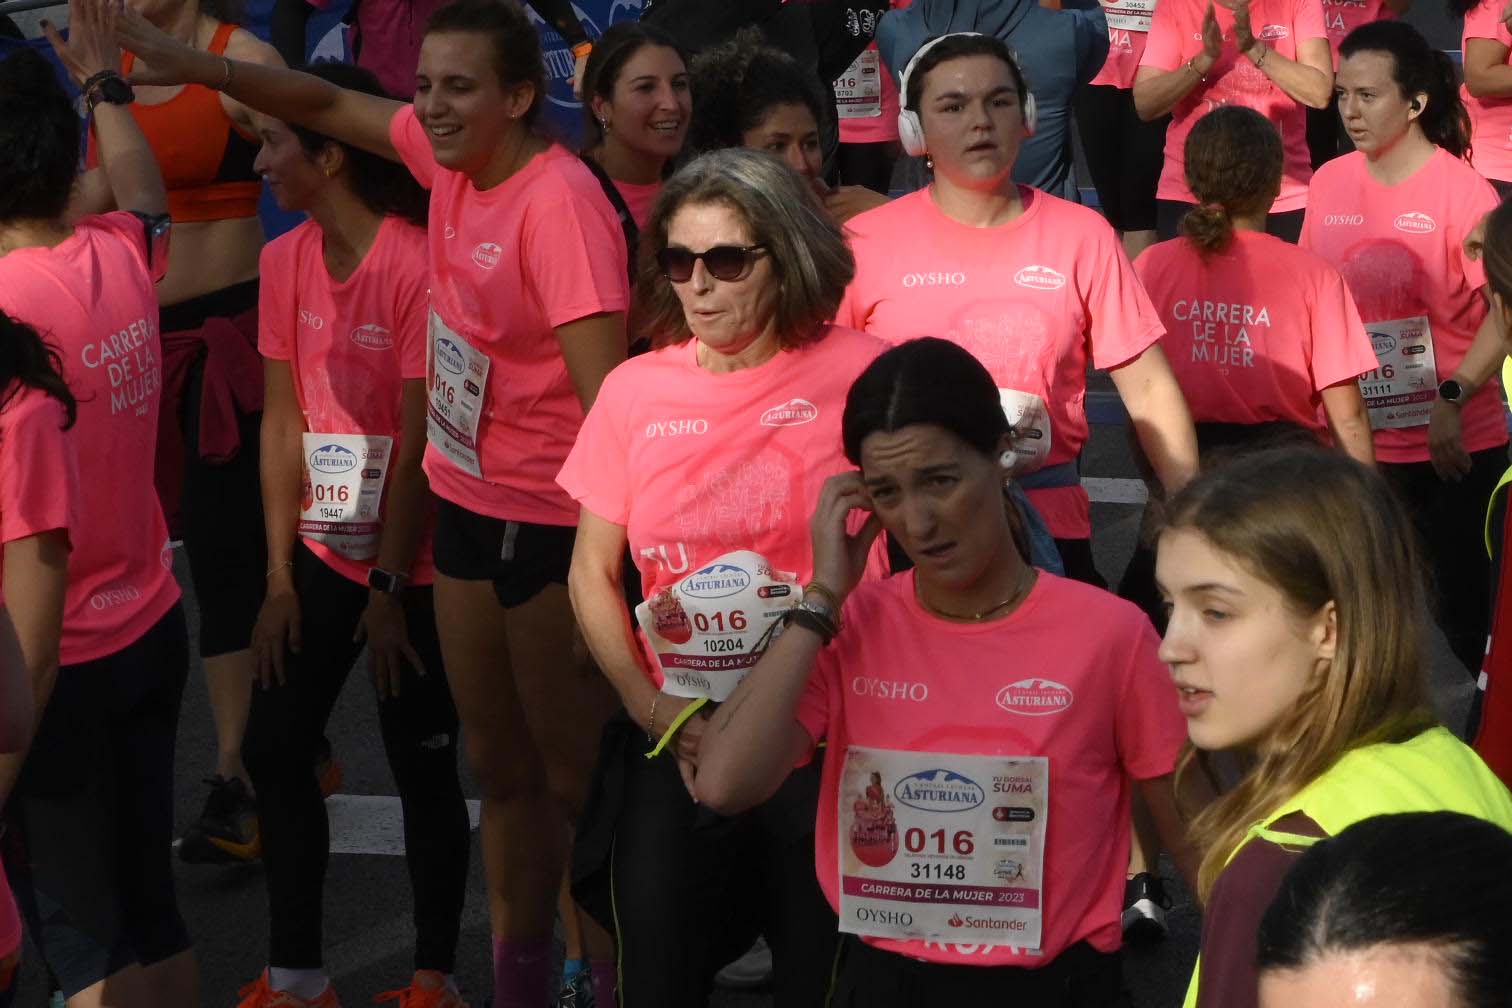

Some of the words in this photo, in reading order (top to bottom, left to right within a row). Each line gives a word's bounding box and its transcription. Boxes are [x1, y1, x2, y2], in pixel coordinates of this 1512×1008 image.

[1324, 214, 1364, 227] OYSHO
[903, 271, 966, 289] OYSHO
[1173, 298, 1271, 328] CARRERA
[81, 316, 158, 371] CARRERA
[1224, 324, 1251, 347] LA
[108, 359, 132, 388] DE
[136, 350, 155, 374] LA
[110, 369, 160, 415] MUJER
[435, 373, 455, 404] 016
[1362, 384, 1391, 396] 31111
[645, 419, 709, 439] OYSHO
[315, 484, 349, 502] 016
[319, 507, 344, 519] 19447
[685, 577, 745, 592] ASTURIANA
[90, 585, 140, 611] OYSHO
[693, 609, 747, 632] 016
[703, 637, 744, 653] 10204
[708, 658, 720, 668] DE
[722, 658, 735, 667] LA
[853, 676, 929, 702] OYSHO
[1000, 691, 1067, 707] ASTURIANA
[901, 783, 978, 804] ASTURIANA
[992, 782, 1033, 793] SUMA
[904, 827, 975, 856] 016
[910, 863, 966, 880] 31148
[860, 883, 912, 899] CARRERA
[915, 888, 931, 898] DE
[934, 889, 950, 899] LA
[952, 890, 993, 902] MUJER
[998, 892, 1025, 903] 2023
[856, 906, 913, 927] OYSHO
[965, 916, 1027, 931] Santander
